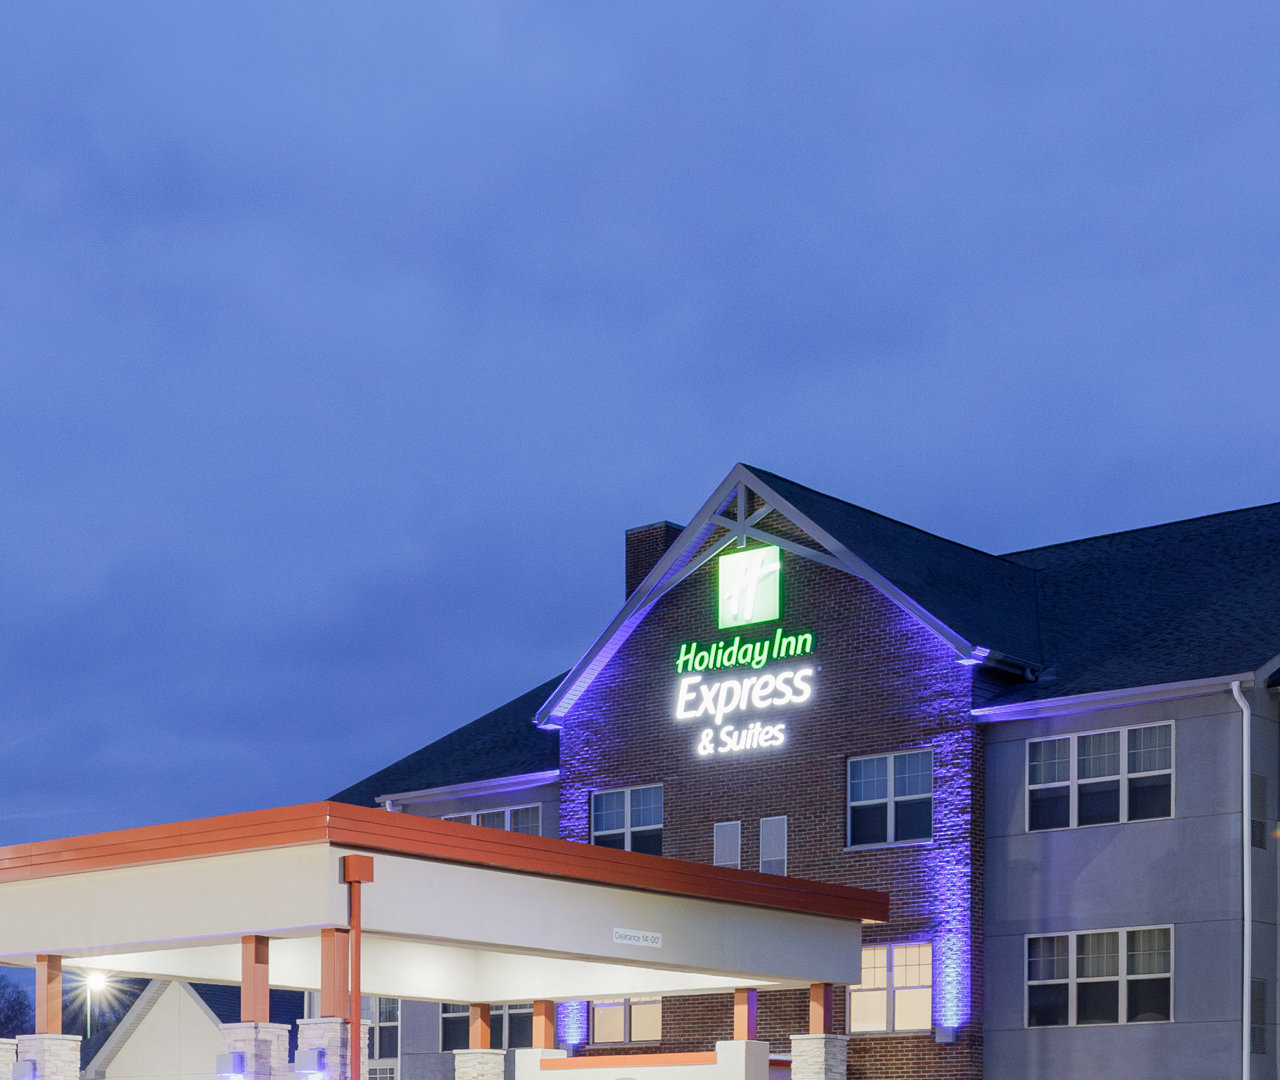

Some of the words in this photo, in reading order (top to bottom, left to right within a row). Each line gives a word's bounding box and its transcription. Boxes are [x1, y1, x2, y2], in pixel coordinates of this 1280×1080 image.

[676, 636, 770, 673] Holiday
[772, 628, 813, 658] Inn
[675, 669, 813, 725] Express
[697, 728, 715, 755] &
[717, 722, 786, 753] Suites
